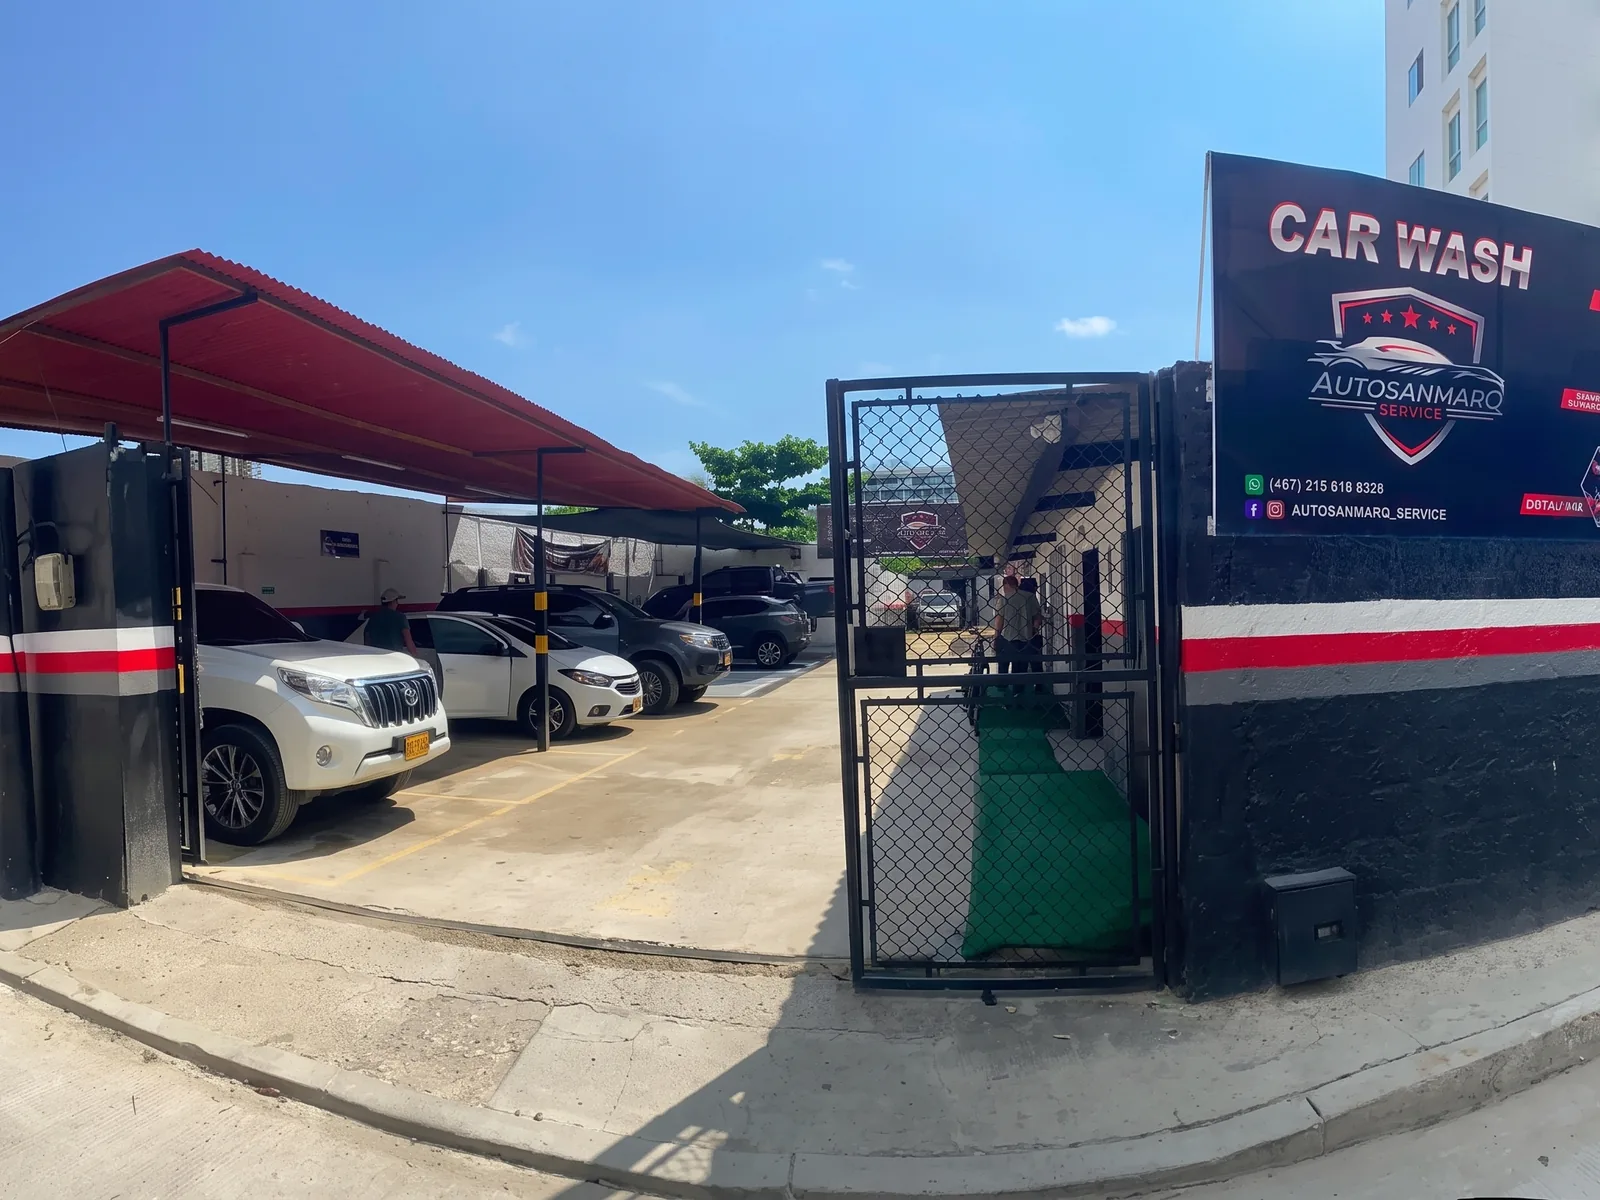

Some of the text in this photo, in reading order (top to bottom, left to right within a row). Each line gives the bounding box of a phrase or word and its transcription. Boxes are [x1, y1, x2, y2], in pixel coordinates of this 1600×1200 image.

[1269, 201, 1533, 290] CAR WASH
[1311, 371, 1504, 415] AUTOSANMARQ
[1379, 403, 1442, 420] SERVICE
[1269, 477, 1384, 494] (467) 215 618 8328
[1291, 504, 1447, 521] AUTOSANMARQ_SERVICE
